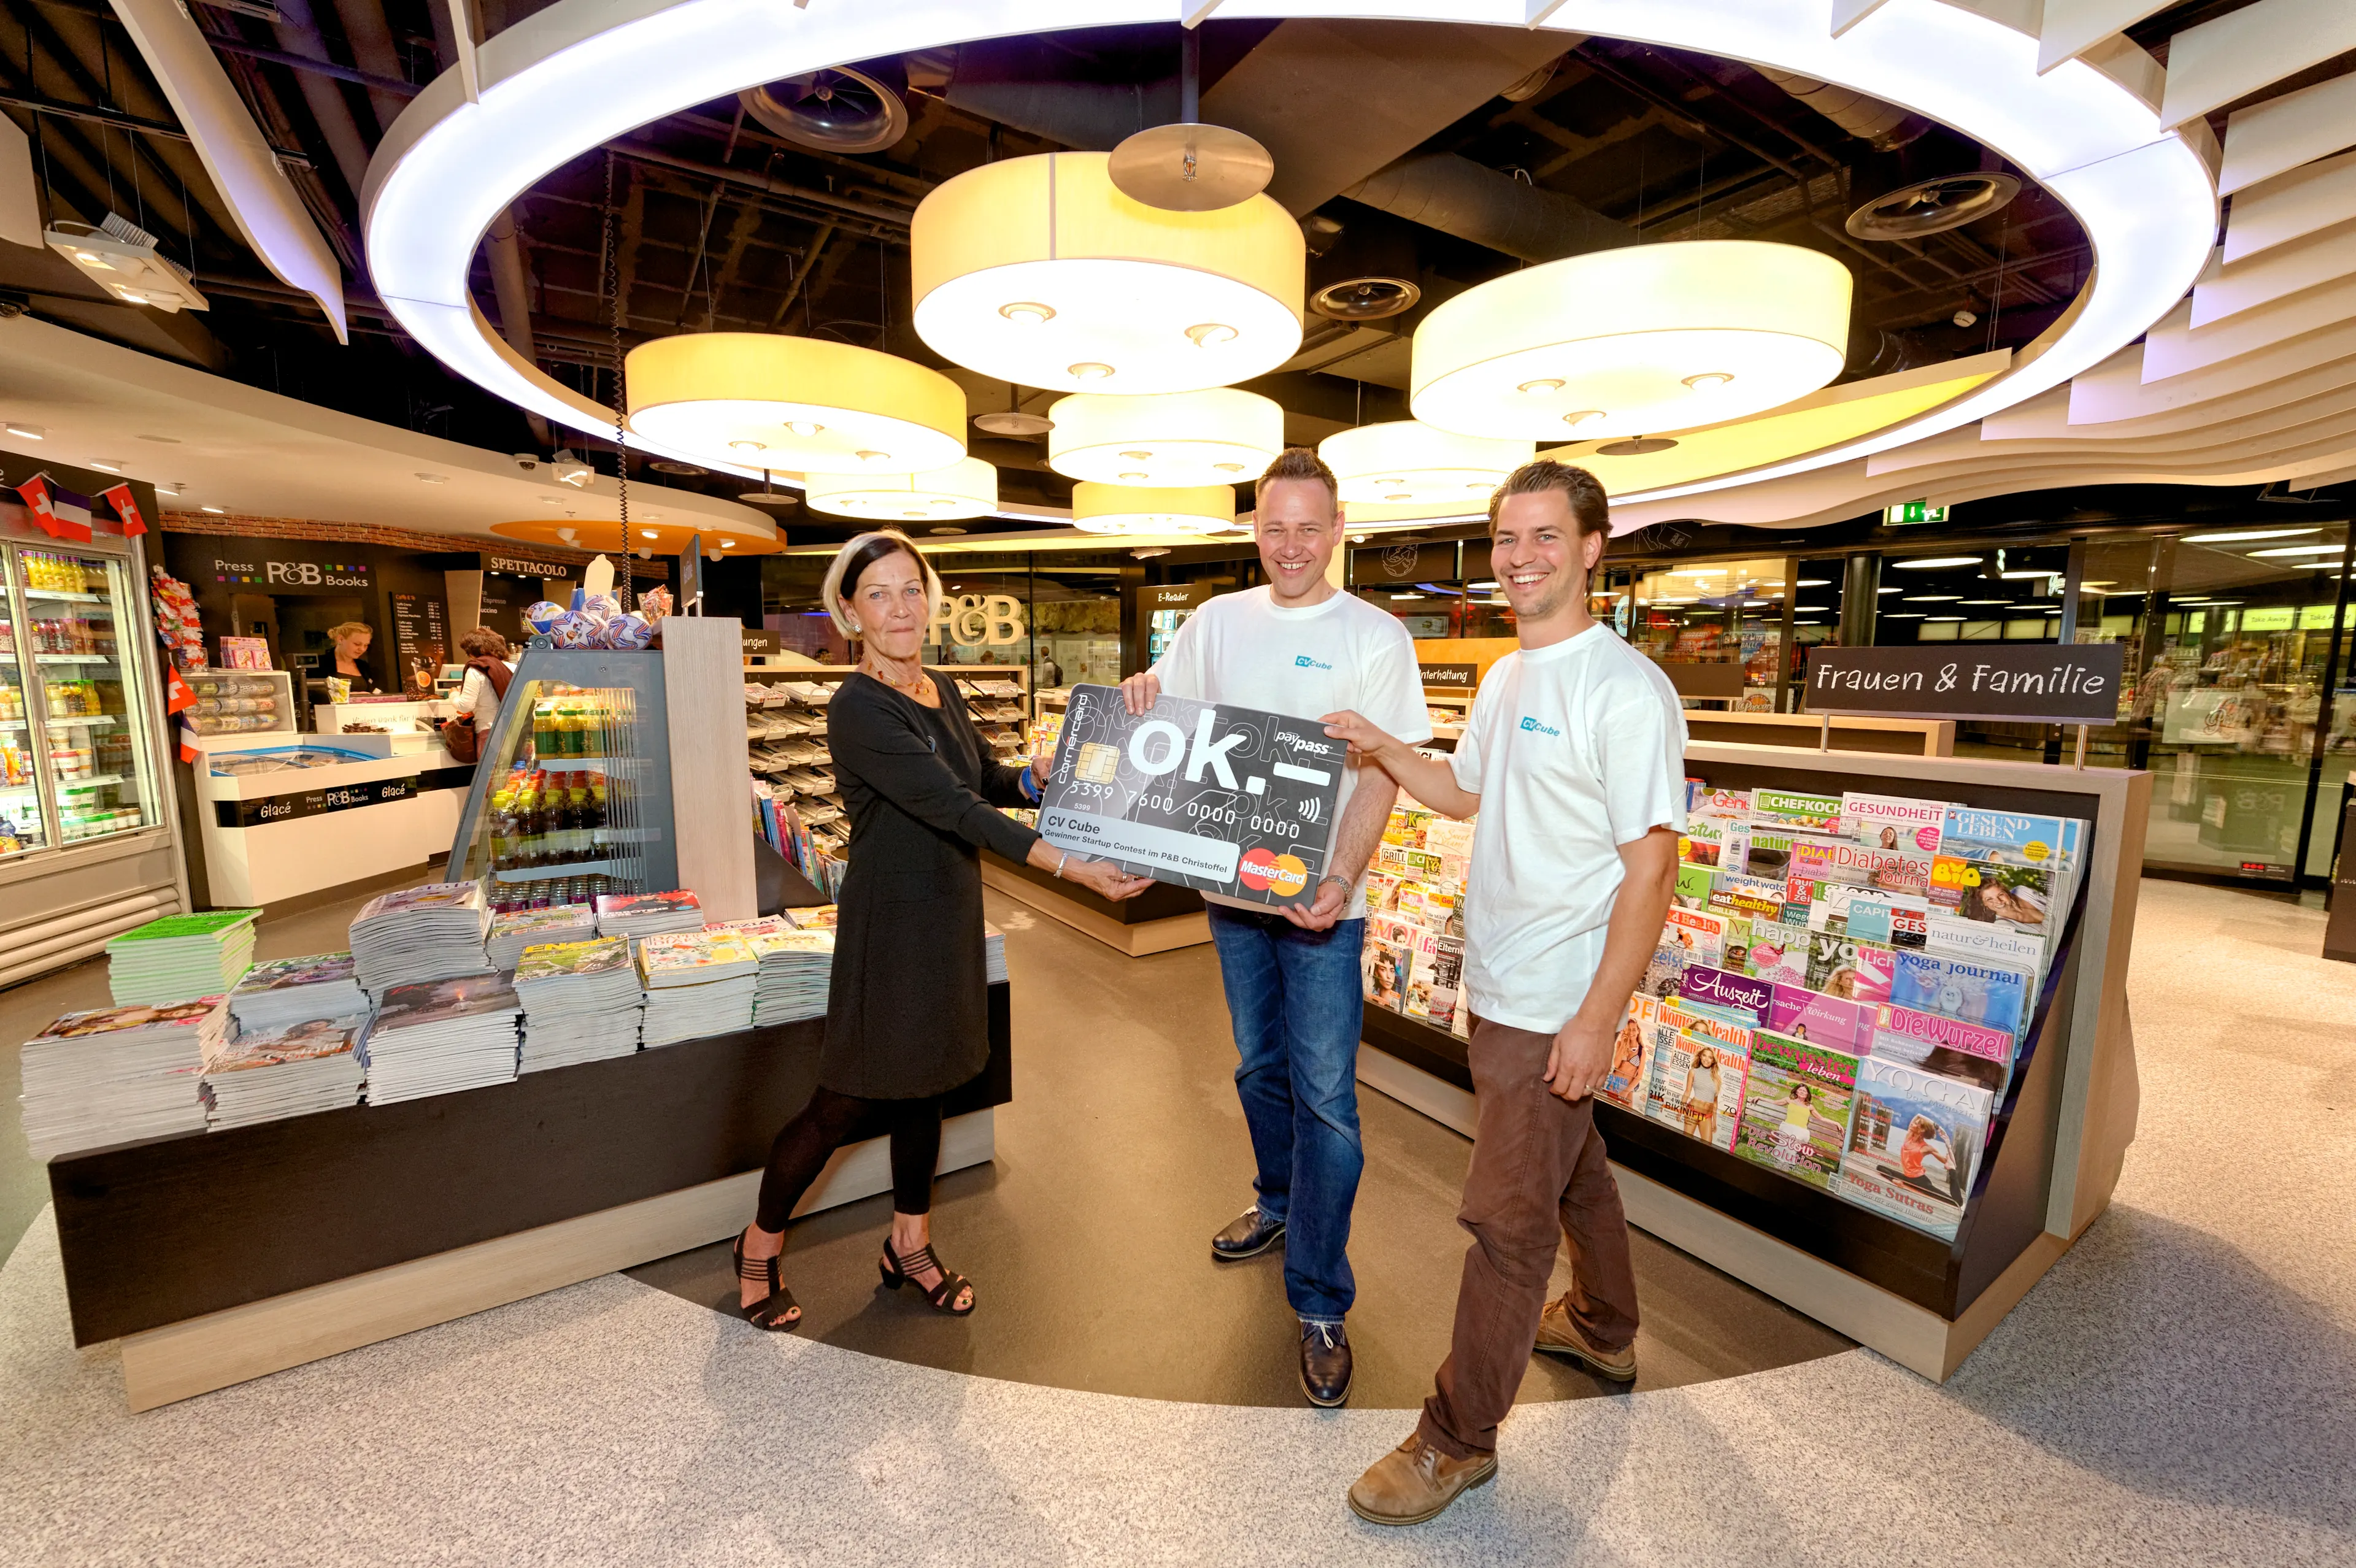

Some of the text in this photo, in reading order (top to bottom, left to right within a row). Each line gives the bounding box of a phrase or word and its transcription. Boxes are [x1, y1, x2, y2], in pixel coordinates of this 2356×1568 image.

[215, 559, 368, 586] Press P&B Books
[491, 557, 566, 577] SPETTACOLO
[1158, 592, 1189, 602] E-Reader
[929, 594, 1025, 646] P&B
[742, 638, 768, 650] ungen
[1817, 663, 2105, 694] Frauen & Familie
[260, 801, 291, 818] Glacé
[327, 790, 350, 807] P&B
[351, 794, 369, 803] Books
[382, 783, 405, 798] Glacé
[1069, 780, 1300, 839] 5399 7600 0000 0000
[1074, 802, 1091, 811] 5399
[1770, 796, 1841, 815] CHEFKOCH
[1849, 802, 1943, 821] GESUNDHEIT
[1957, 812, 2031, 830] GESUND
[1047, 815, 1101, 834] CV Cube
[1957, 823, 2015, 840] LEBEN
[1044, 829, 1228, 874] Gewinner Startup Contest im P&B Christoffel
[1383, 850, 1406, 863] GRILL
[1838, 847, 1930, 877] Diabetes
[1239, 860, 1306, 885] MasterCard
[1725, 874, 1760, 888] weight
[1797, 886, 1806, 895] &
[1708, 905, 1740, 917] GRILLEN
[1682, 912, 1719, 932] Health
[1893, 918, 1927, 933] GES
[1900, 953, 2020, 985] yoga journal
[1689, 972, 1768, 1012] Auszeit
[1807, 1007, 1847, 1026] Wirkung
[1890, 1007, 2008, 1058] Die Wurzel
[1672, 1059, 1690, 1070] ESSEN
[1673, 1053, 1690, 1064] ALLES
[1755, 1034, 1855, 1076] bewusster
[1807, 1063, 1841, 1082] leben
[1866, 1059, 1975, 1110] YOGA
[1928, 1099, 1974, 1119] Magazin
[1748, 1126, 1768, 1140] Die
[1747, 1137, 1822, 1174] Revolution
[1849, 1172, 1935, 1214] Yoga Sutras
